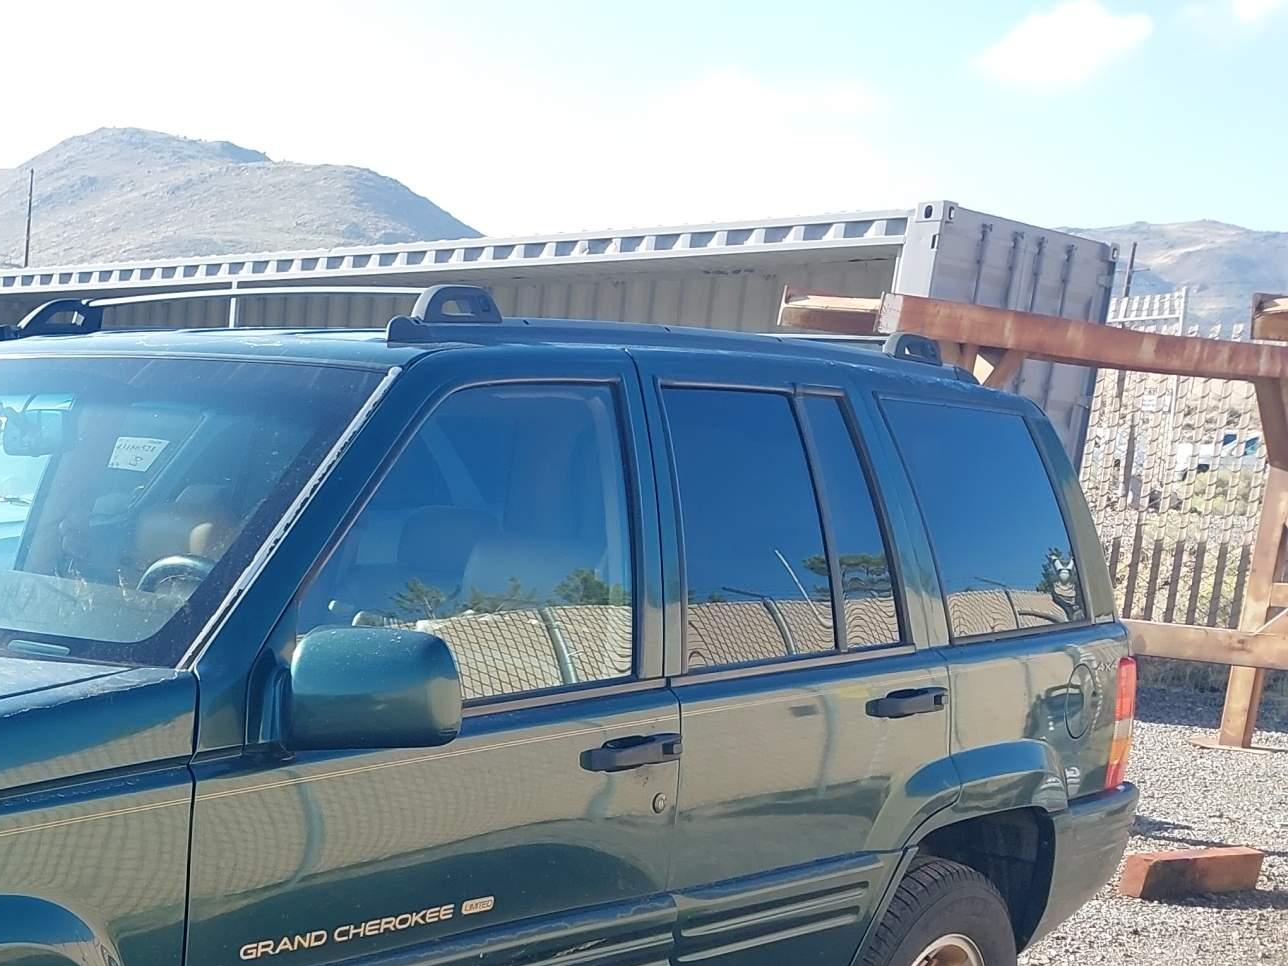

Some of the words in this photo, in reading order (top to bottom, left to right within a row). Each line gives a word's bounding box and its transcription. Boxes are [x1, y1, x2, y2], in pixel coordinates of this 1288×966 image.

[239, 929, 329, 961] GRAND
[333, 903, 456, 943] CHEROKEE
[463, 898, 493, 912] LIMITED
